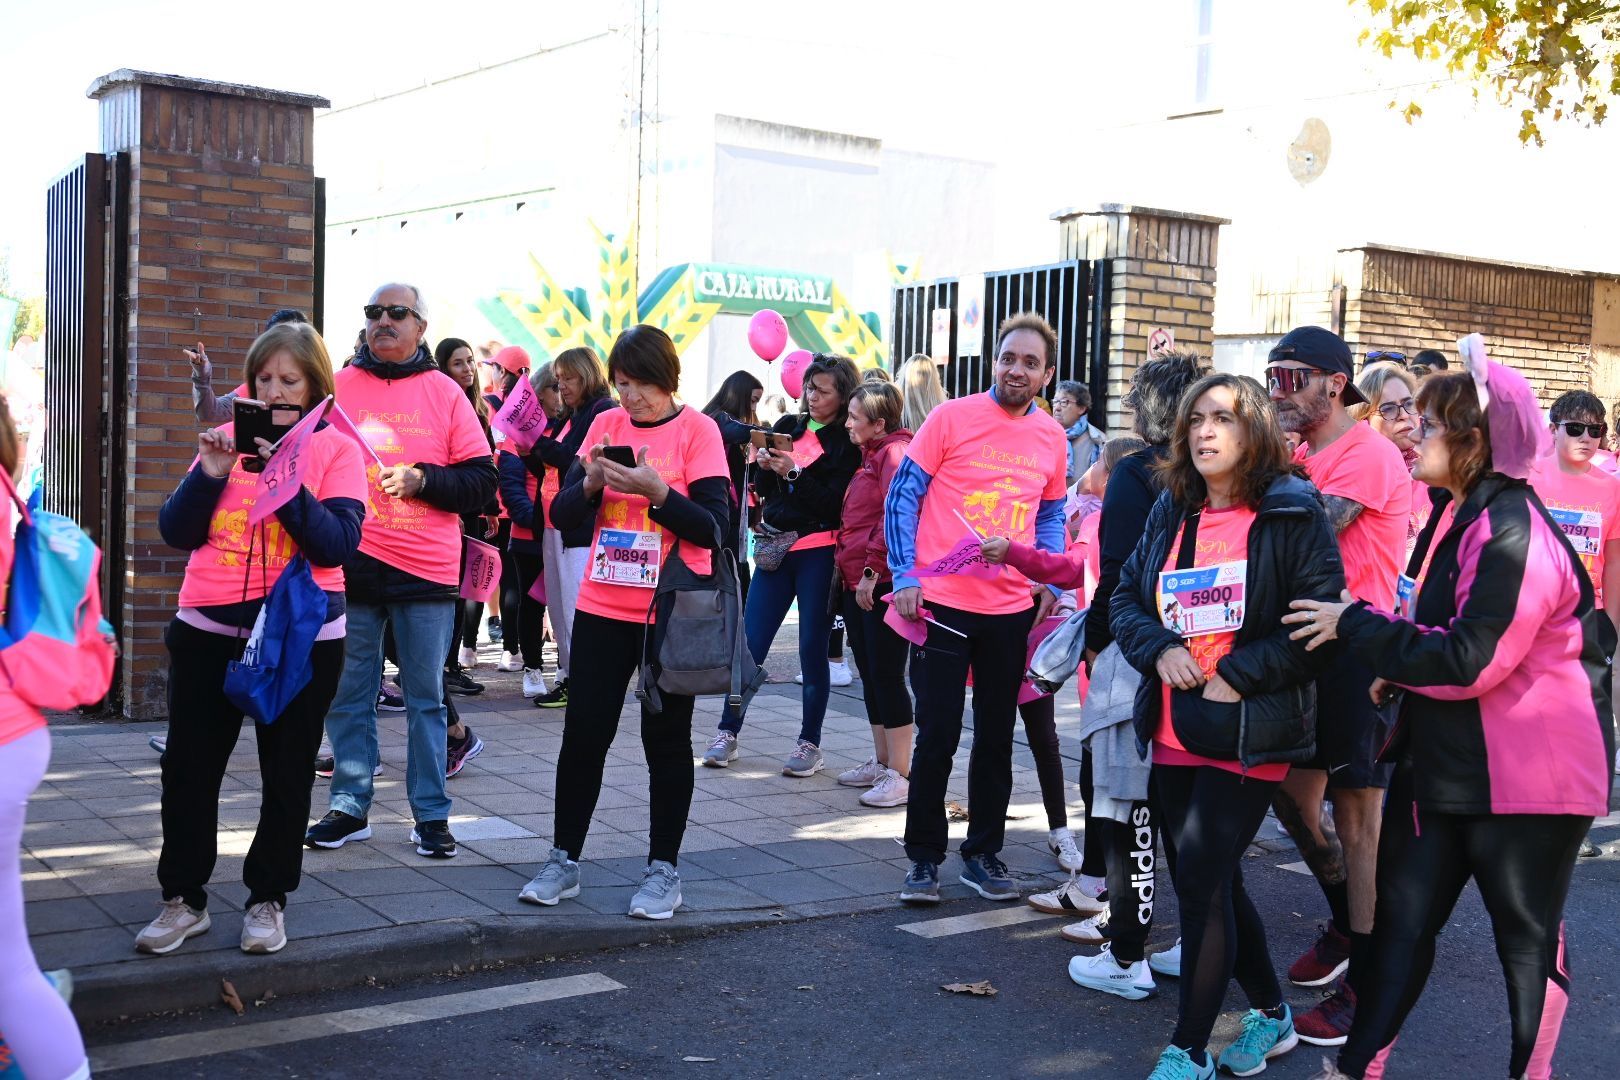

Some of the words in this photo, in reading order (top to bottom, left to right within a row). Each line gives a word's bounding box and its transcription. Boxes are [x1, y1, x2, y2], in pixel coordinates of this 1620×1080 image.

[700, 271, 753, 299] CAJA
[755, 275, 832, 305] RURAL
[358, 409, 420, 424] Drasanvi
[982, 444, 1038, 469] Drasanvi
[1561, 524, 1590, 536] 3797
[613, 548, 649, 563] 0894
[481, 555, 495, 591] Ezedent
[1190, 586, 1233, 607] 5900
[1183, 612, 1194, 631] 11
[1130, 806, 1155, 925] adidas
